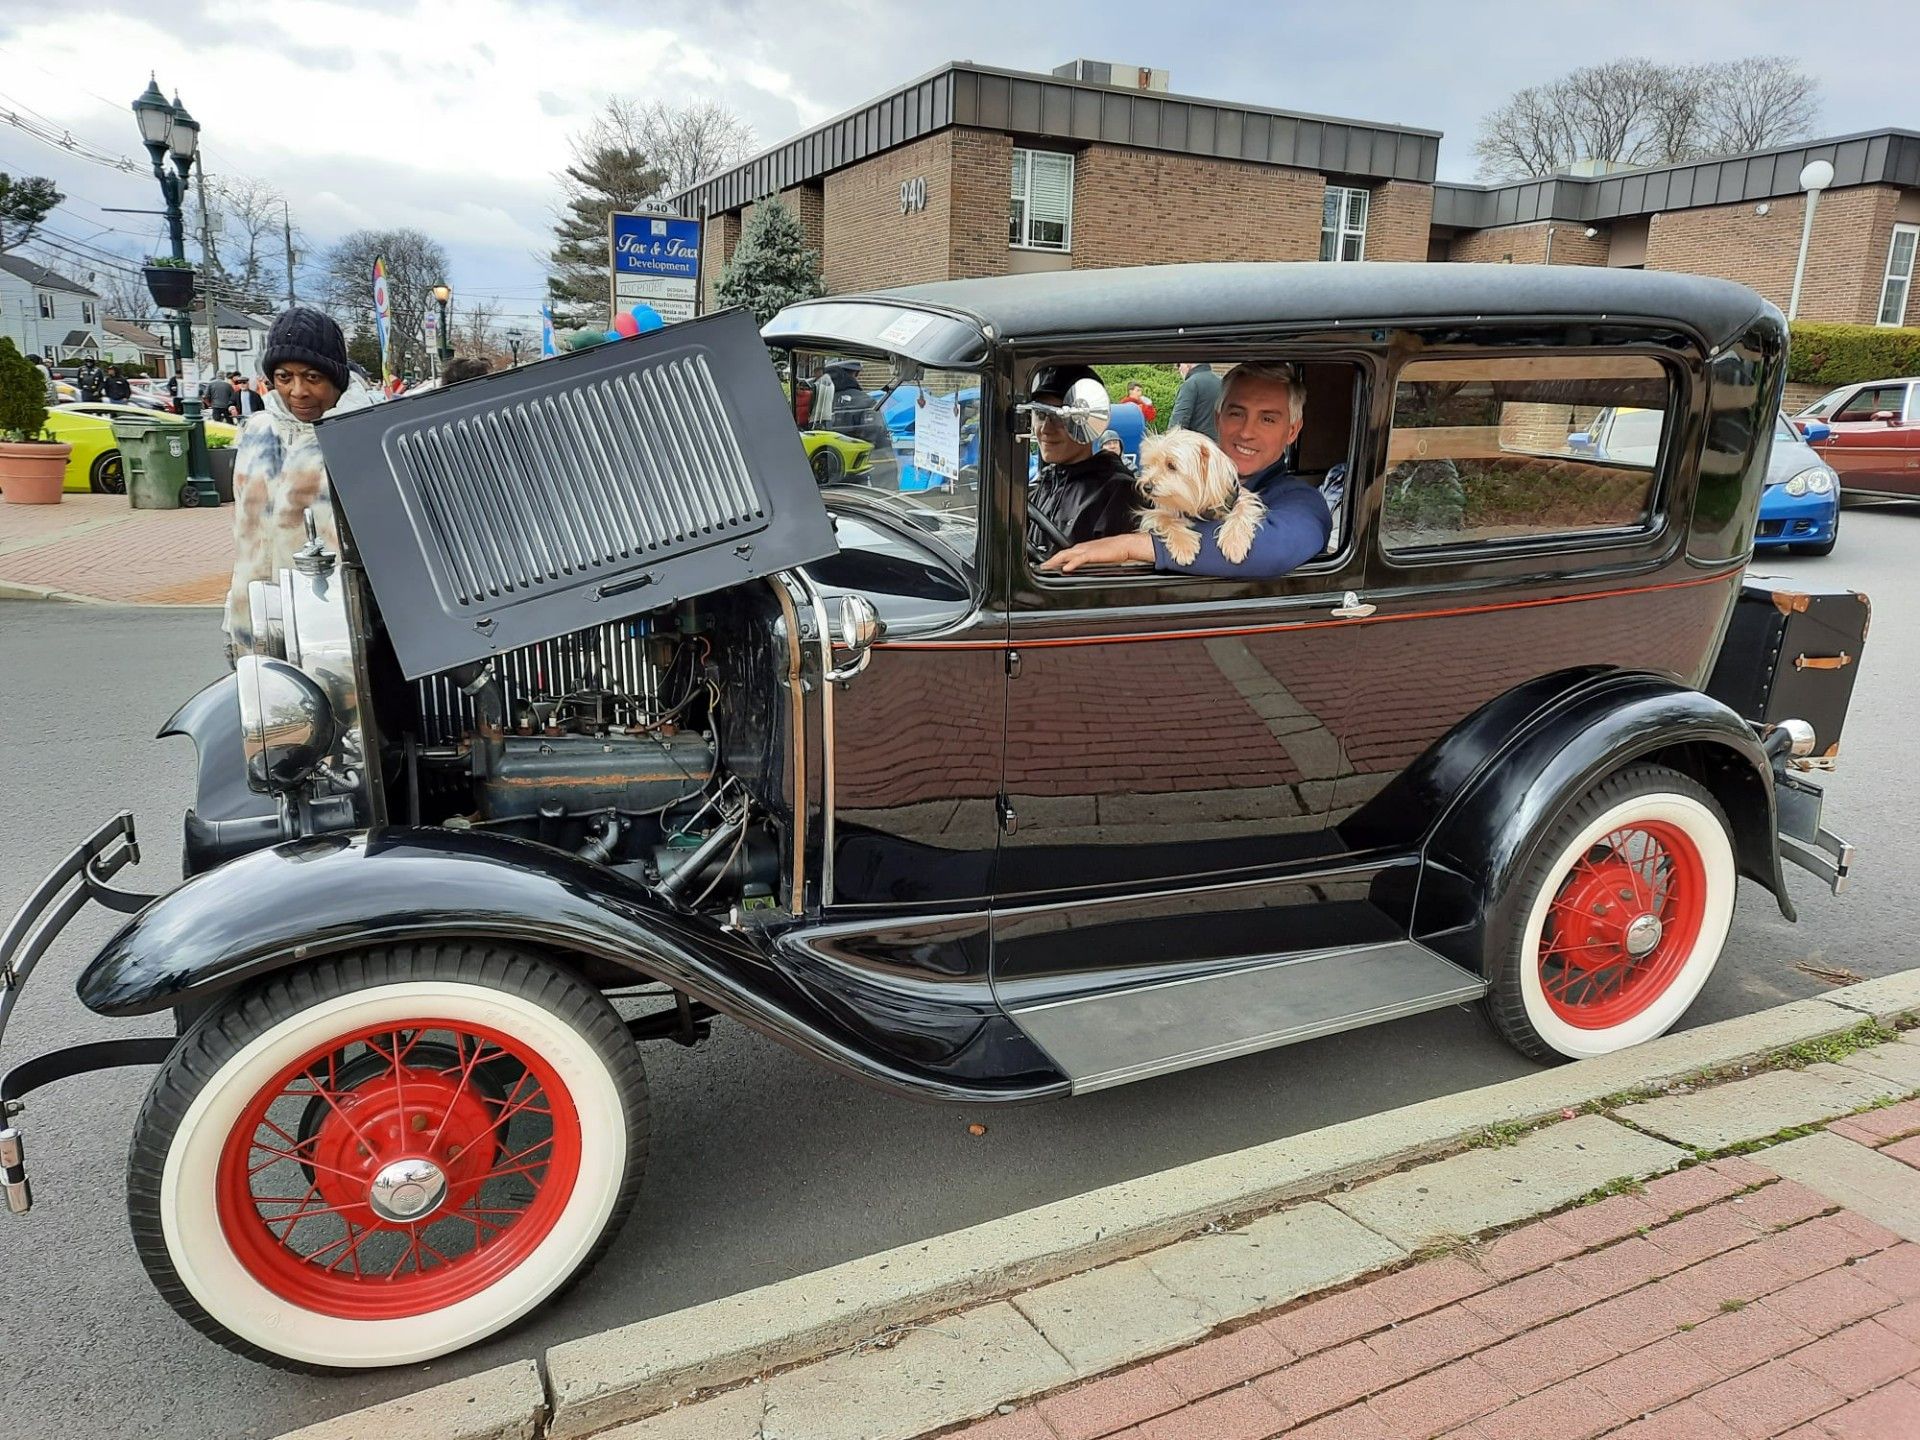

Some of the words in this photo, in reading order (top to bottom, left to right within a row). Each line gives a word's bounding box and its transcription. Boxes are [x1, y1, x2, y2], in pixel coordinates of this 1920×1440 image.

[900, 176, 926, 213] 940
[646, 203, 668, 213] 940
[650, 241, 661, 256] &
[628, 256, 690, 272] Development
